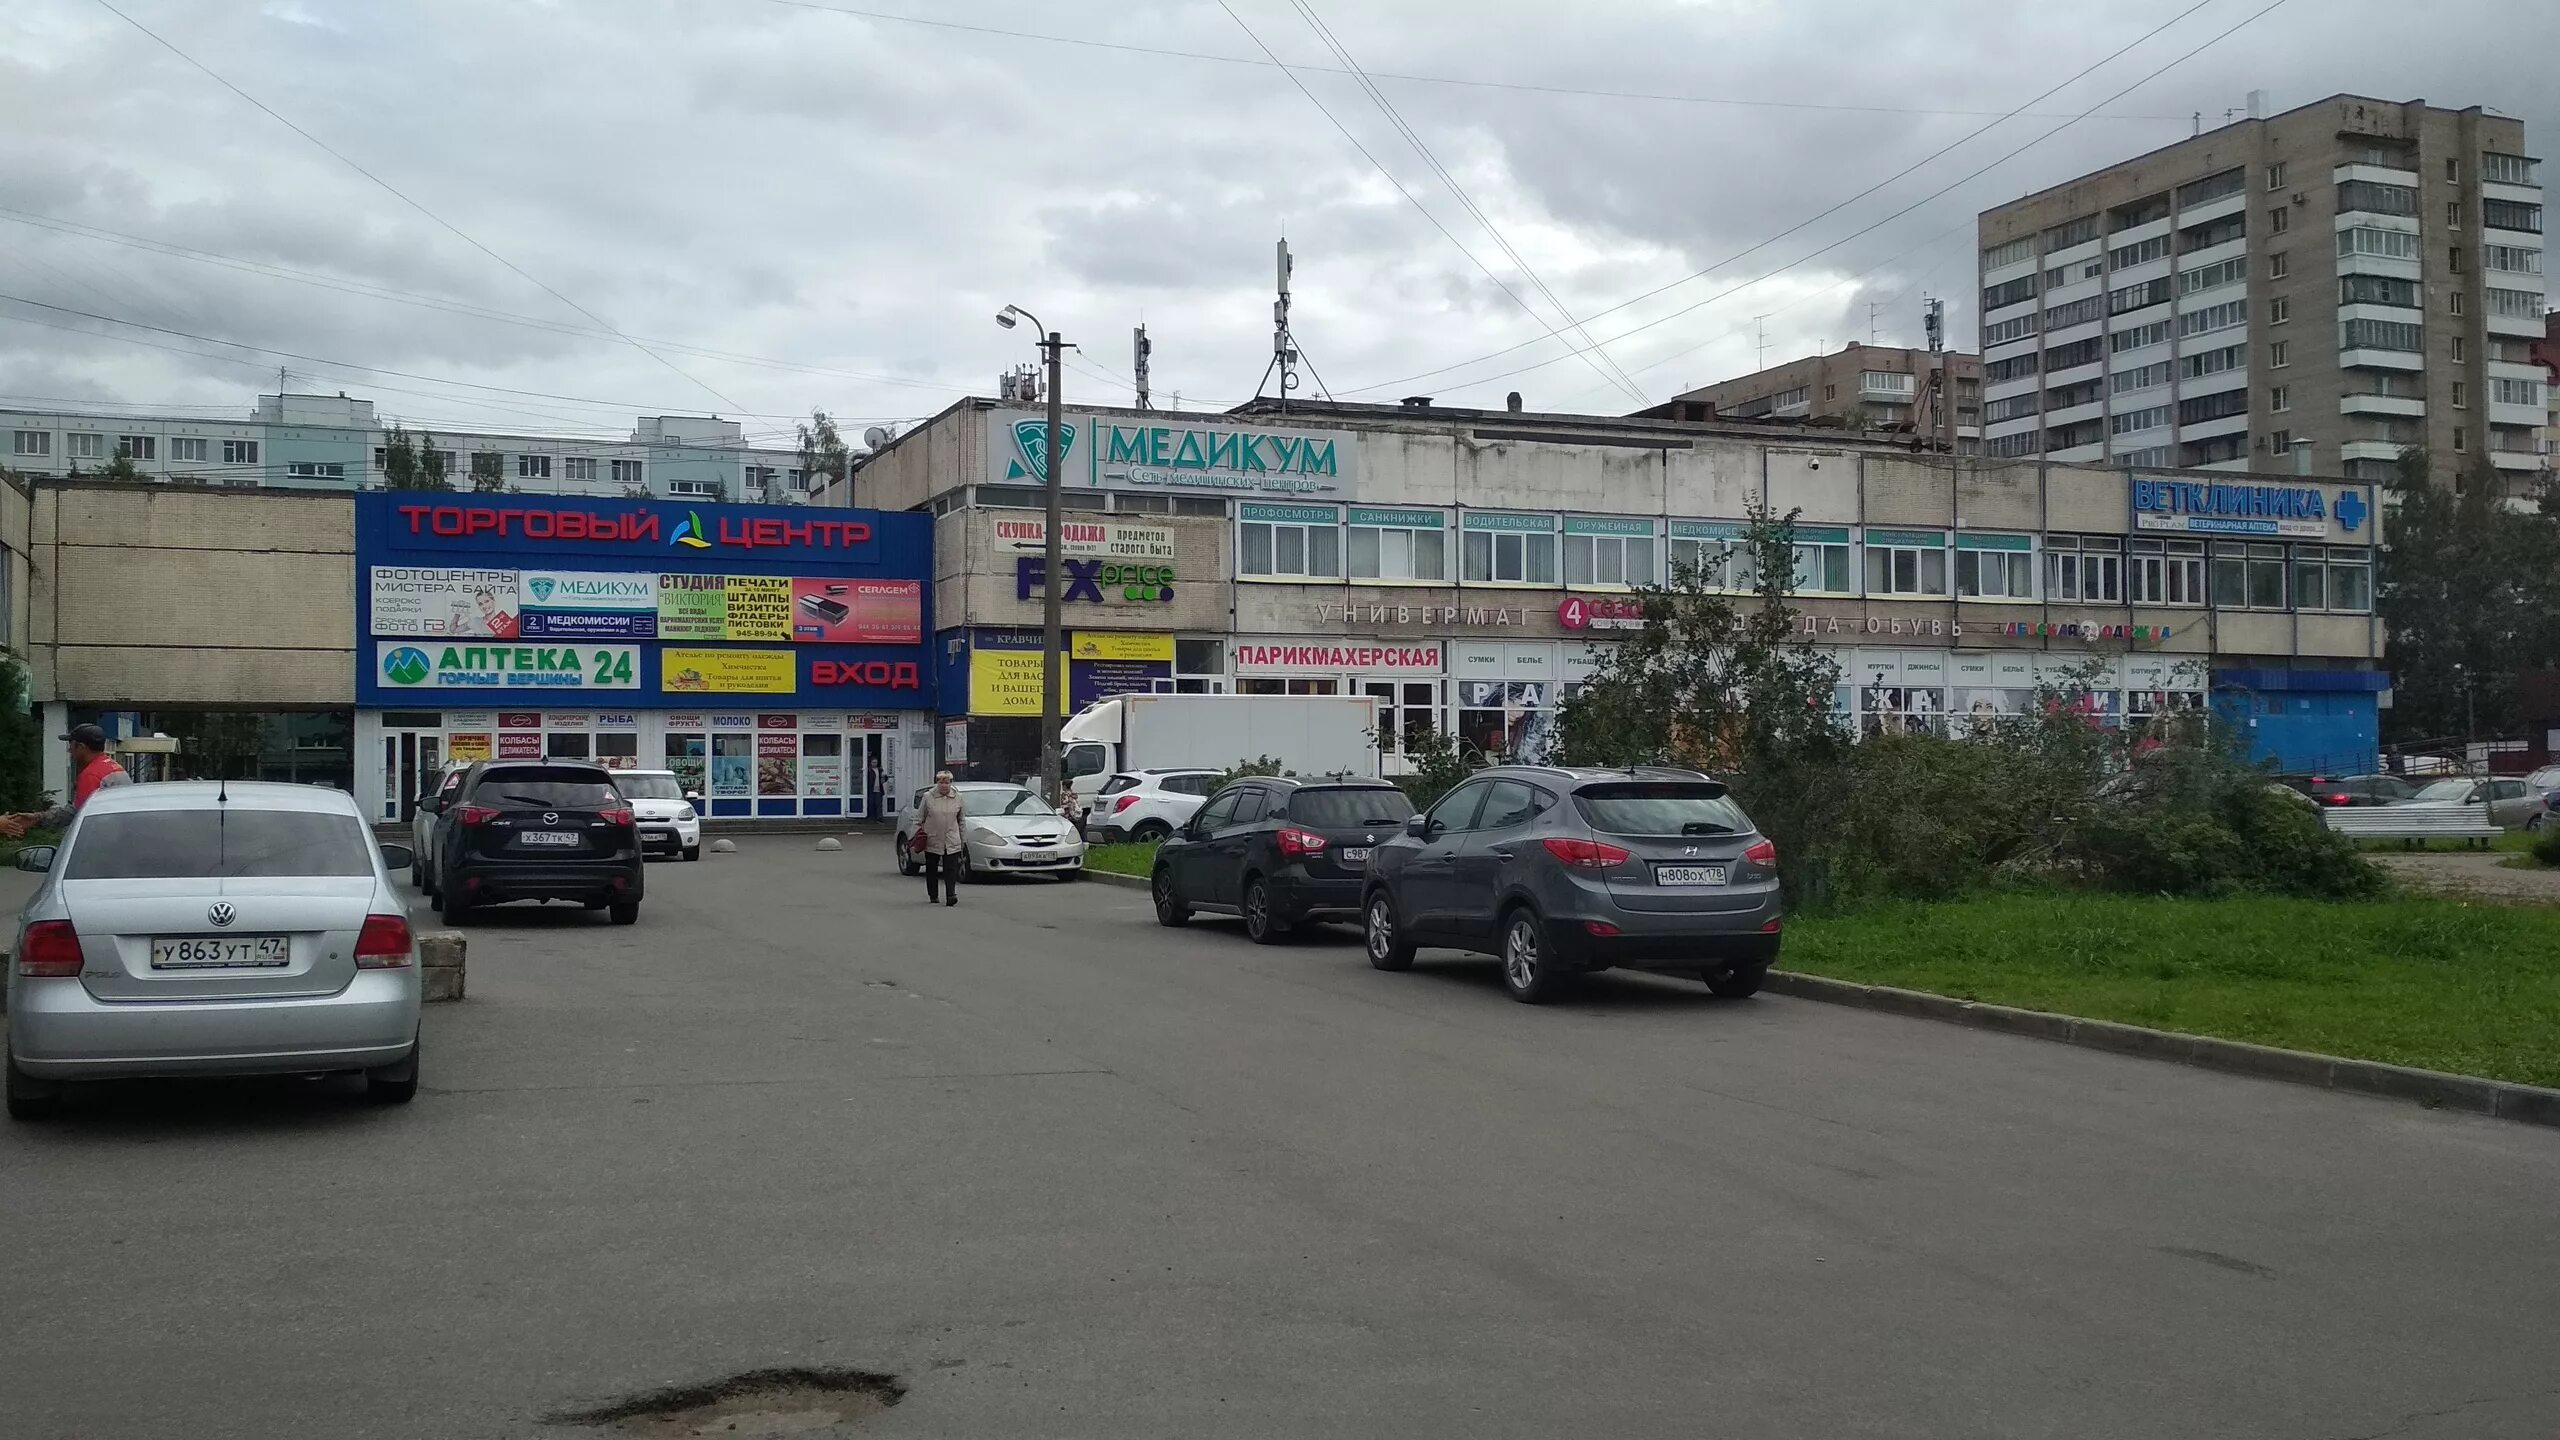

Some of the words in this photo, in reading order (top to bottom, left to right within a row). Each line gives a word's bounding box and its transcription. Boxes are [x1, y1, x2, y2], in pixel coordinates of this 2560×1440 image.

[1106, 424, 1338, 477] МЕДИКУМ
[1127, 465, 1163, 483] Сеть
[1166, 472, 1255, 489] медицинских
[1260, 478, 1318, 496] центров
[2134, 479, 2327, 518] ВЕТКЛИНИКА
[1242, 506, 1334, 522] ПРОФОСМОТРЫ
[1360, 511, 1433, 525] САНКНИЖКИ
[399, 505, 660, 541] ТОРГОВЫЙ
[1465, 516, 1550, 530] ВОДИТЕЛЬСКАЯ
[1576, 519, 1642, 532] ОРУЖЕЙНАЯ
[2189, 519, 2247, 530] ВЕТЕРИНАРНАЯ
[2249, 521, 2277, 531] АПТЕКА
[720, 517, 871, 549] ЦЕНТР
[1117, 529, 1166, 542] предметов
[1110, 543, 1145, 554] старого
[1150, 544, 1172, 556] быта
[376, 569, 517, 583] ФОТОЦЕНТРЫ
[1101, 563, 1175, 589] price
[376, 583, 456, 593] МИСТЕРА
[462, 584, 517, 594] БАЙТА
[560, 580, 648, 595] МЕДИКУМ
[660, 575, 725, 592] СТУДИЯ
[727, 578, 789, 588] ПЕЧАТИ
[858, 585, 908, 594] CERAGEM
[727, 592, 789, 603] ШТАМПЫ
[727, 604, 789, 613] ВИЗИТКИ
[1566, 600, 1582, 625] 4
[727, 612, 789, 620] ФЛАЕРЫ
[1316, 602, 1531, 627] УНИВЕРМАГ
[530, 616, 537, 626] 2
[547, 615, 630, 626] МЕДКОМИССИИ
[728, 620, 784, 629] ЛИСТОВКИ
[1867, 616, 1962, 636] ОБУВЬ
[375, 623, 418, 631] ФОТО
[2004, 622, 2081, 637] ДЕТСКАЯ
[2101, 624, 2172, 640] ОДЕЖДА
[736, 629, 778, 637] 945-89-94
[438, 647, 582, 671] АПТЕКА
[717, 652, 750, 660] ремонту
[752, 652, 784, 660] одежды
[1239, 645, 1439, 667] ПАРИКМАХЕРСКАЯ
[594, 650, 632, 684] 24
[721, 662, 767, 671] Химчистка
[998, 659, 1044, 668] ТОВАРЫ
[1868, 663, 1894, 671] КУРТКИ
[437, 672, 499, 685] ГОРНЫЕ
[507, 672, 582, 686] ВЕРШИНЫ
[707, 673, 738, 681] Товары
[812, 661, 919, 689] ВХОД
[999, 671, 1020, 680] ДЛЯ
[1023, 672, 1045, 681] ВАС
[727, 682, 769, 690] рукоделия
[991, 684, 1000, 692] И
[1003, 685, 1044, 693] ВАШЕГ
[1003, 696, 1036, 706] ДОМА
[600, 715, 634, 724] РЫБА
[713, 716, 751, 726] МОЛОКО
[500, 736, 540, 744] КОЛБАСЫ
[500, 746, 540, 755] ДЕЛИКАТЕСЫ
[759, 746, 796, 754] ДЕЛИКАТЕСЫ
[669, 759, 703, 767] ОВОЩИ
[525, 832, 563, 843] Х367ТК
[565, 833, 575, 841] 47
[1660, 868, 1704, 881] Н808ОХ
[1706, 868, 1722, 878] 178
[163, 940, 251, 961] У863УТ
[258, 938, 281, 954] 47
